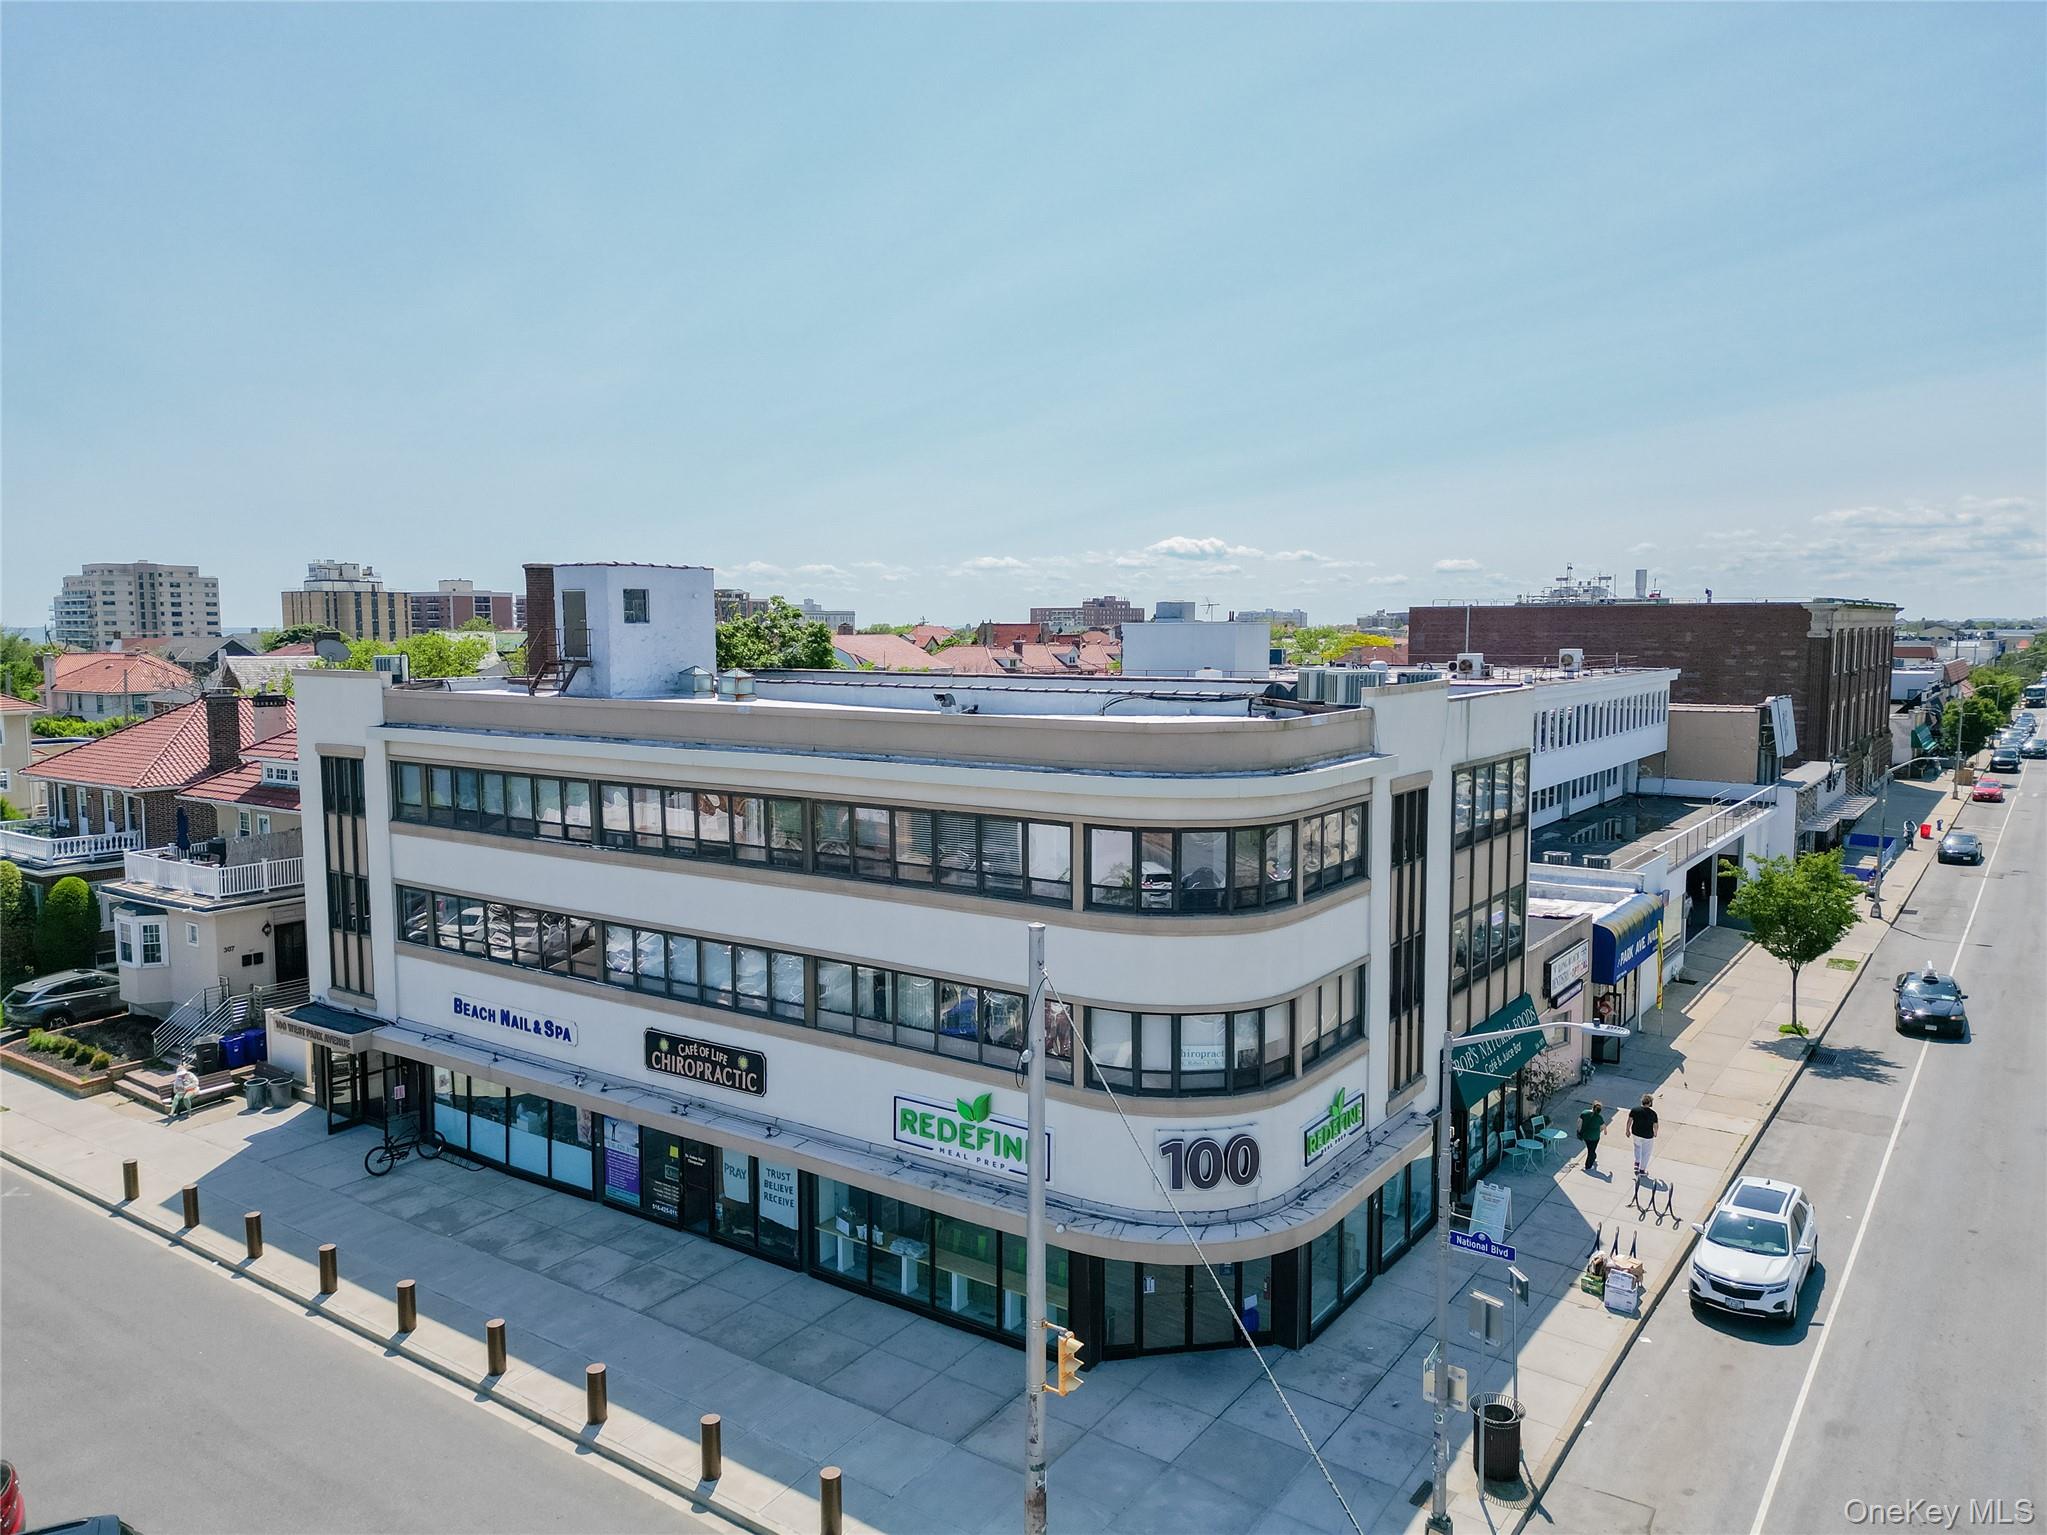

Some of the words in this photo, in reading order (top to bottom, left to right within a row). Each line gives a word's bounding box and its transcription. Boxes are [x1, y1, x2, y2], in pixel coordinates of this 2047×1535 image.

[453, 997, 496, 1023] BEACH
[500, 1009, 531, 1033] NAIL
[533, 1019, 542, 1035] &
[544, 1020, 572, 1042] SPA
[275, 1020, 287, 1032] 100
[287, 1023, 306, 1037] WEST
[306, 1028, 324, 1041] PARK
[324, 1033, 351, 1049] AVENUE
[1453, 1046, 1480, 1077] BOB'S
[1512, 1005, 1537, 1029] FOODS
[678, 1043, 698, 1056] CAFÉ
[699, 1046, 710, 1058] OF
[711, 1048, 728, 1066] LIFE
[651, 1051, 757, 1092] CHIROPRACTIC
[900, 1107, 1029, 1164] REDEFIN
[1307, 1102, 1362, 1157] REDEFINE
[724, 1162, 747, 1180] PRAY
[939, 1147, 969, 1161] MEAL
[976, 1157, 1006, 1170] PREP
[1159, 1133, 1260, 1191] 100
[763, 1179, 794, 1195] BELIEVE
[765, 1167, 791, 1182] TRUST
[763, 1191, 795, 1208] RECEIVE
[1456, 1235, 1488, 1252] National
[1491, 1244, 1509, 1258] Blvd
